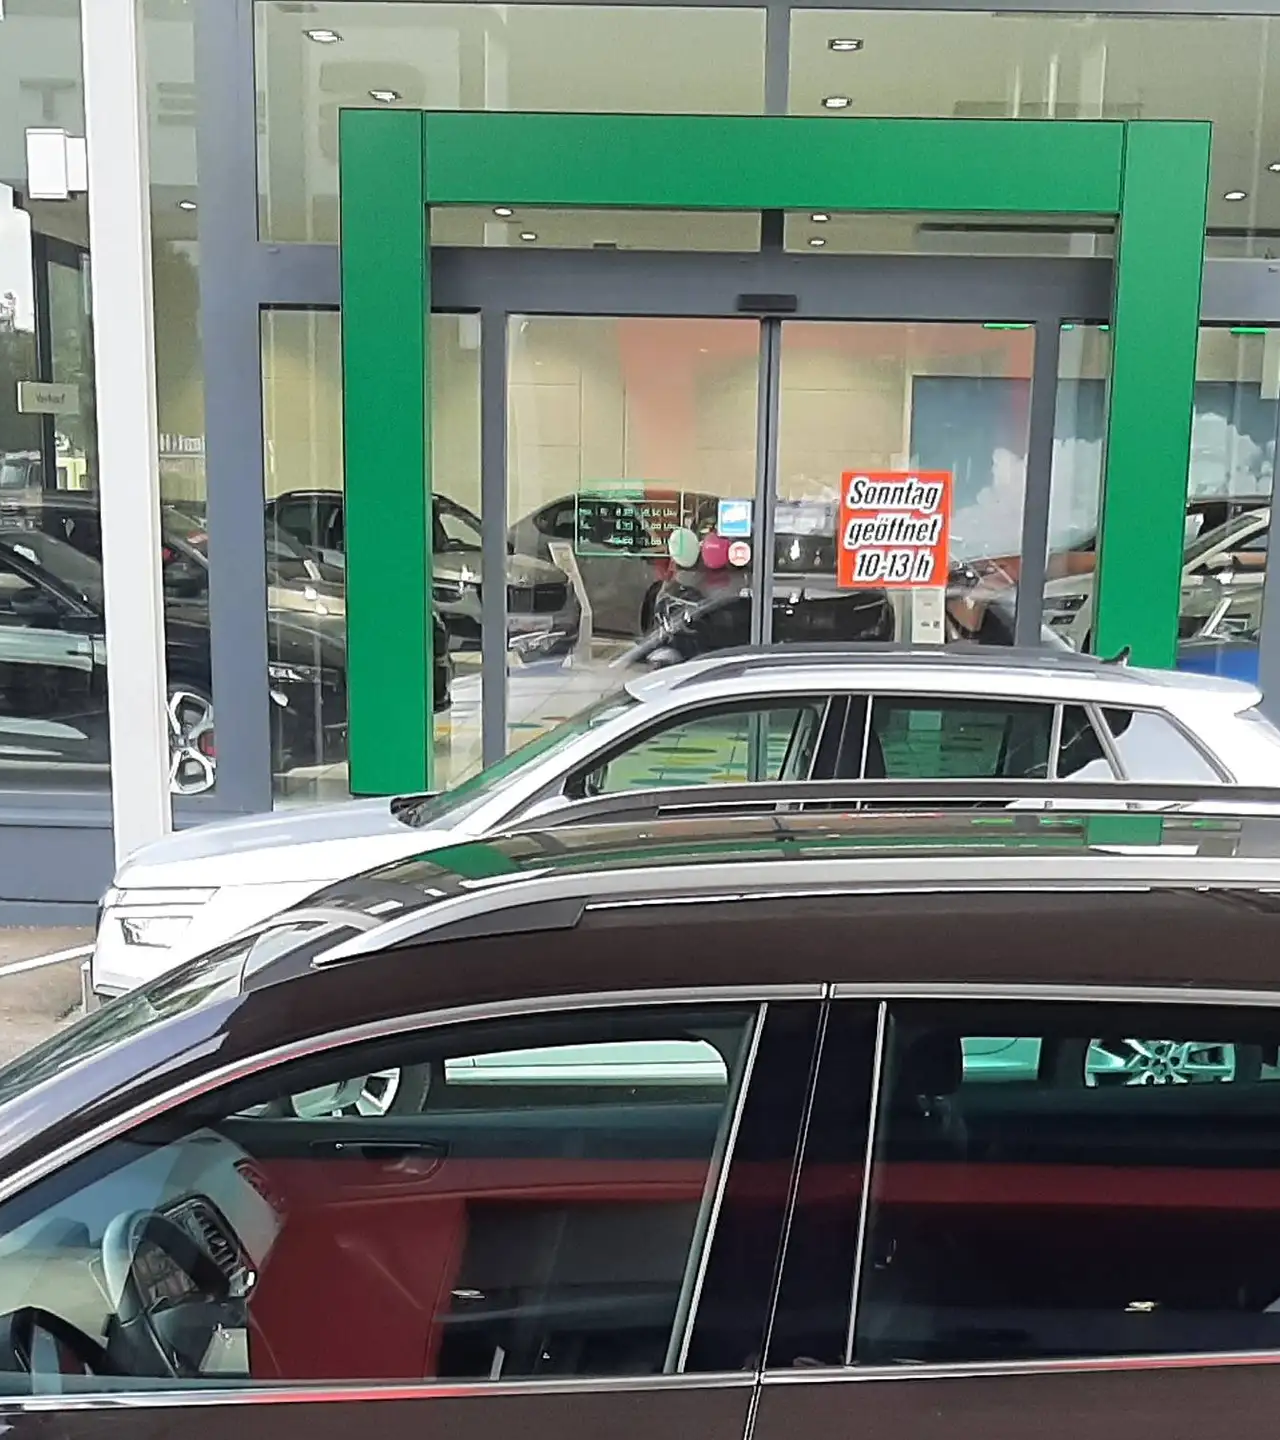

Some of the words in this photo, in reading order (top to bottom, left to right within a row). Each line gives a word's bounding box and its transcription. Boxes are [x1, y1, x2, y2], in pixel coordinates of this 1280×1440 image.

[850, 480, 940, 511] Sonntag
[847, 517, 939, 546] geöffnet
[855, 552, 910, 578] 10-13
[918, 552, 933, 578] h
